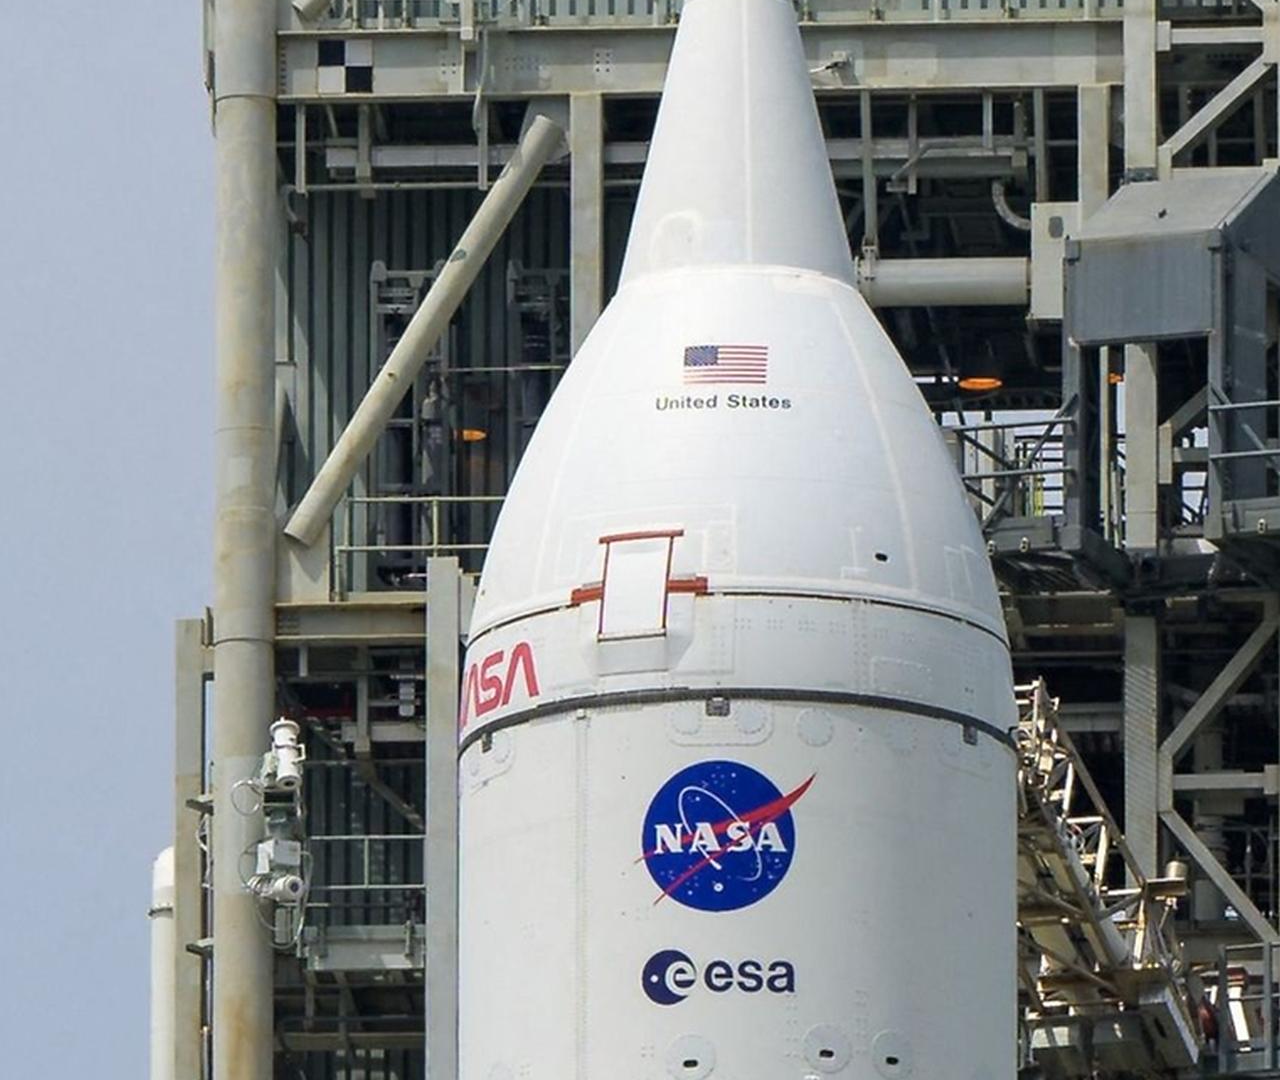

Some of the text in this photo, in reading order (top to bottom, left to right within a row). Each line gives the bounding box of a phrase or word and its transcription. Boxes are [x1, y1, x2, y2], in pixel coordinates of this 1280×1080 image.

[655, 394, 792, 411] United States
[461, 642, 539, 726] ASA
[653, 822, 787, 854] NASA
